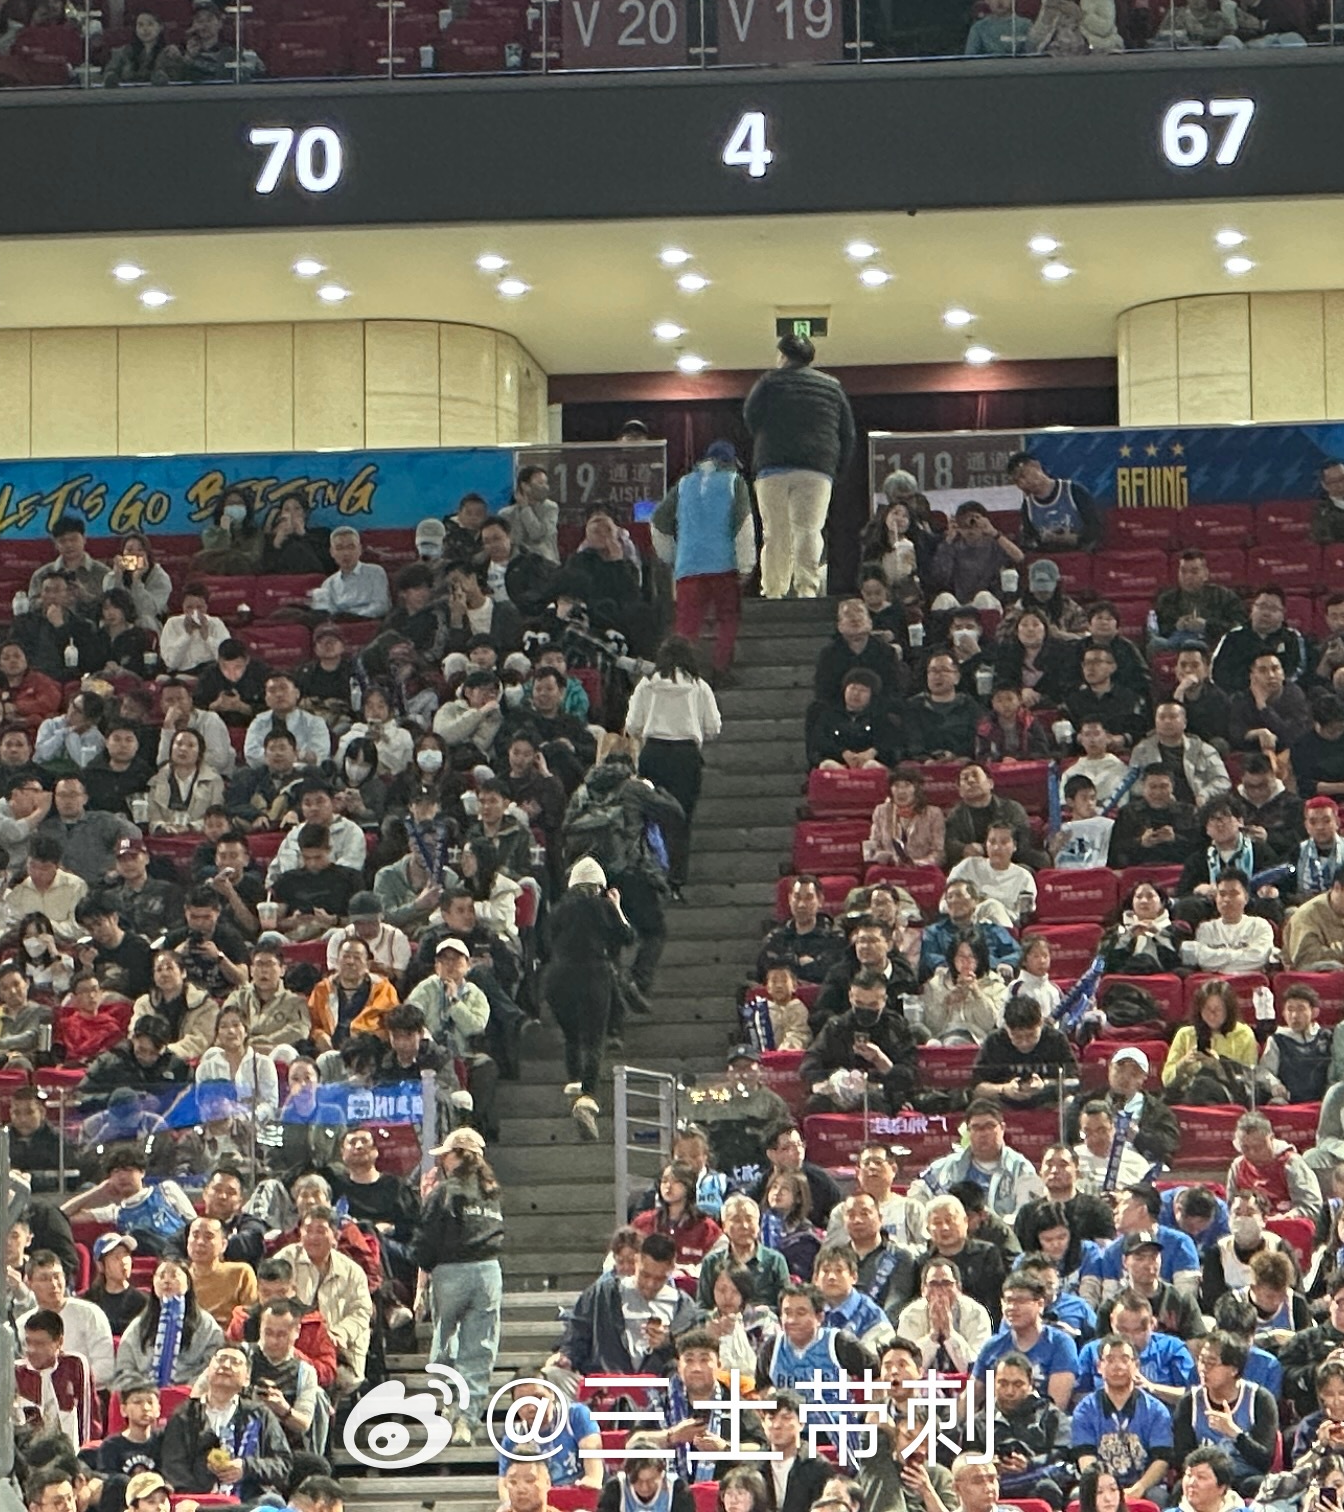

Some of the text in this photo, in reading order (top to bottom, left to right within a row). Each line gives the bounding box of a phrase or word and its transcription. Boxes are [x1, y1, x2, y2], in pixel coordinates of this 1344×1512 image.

[572, 0, 600, 47] V
[248, 126, 345, 194] 70
[722, 111, 774, 178] 4
[1161, 98, 1256, 167] 67
[109, 482, 170, 535] GO
